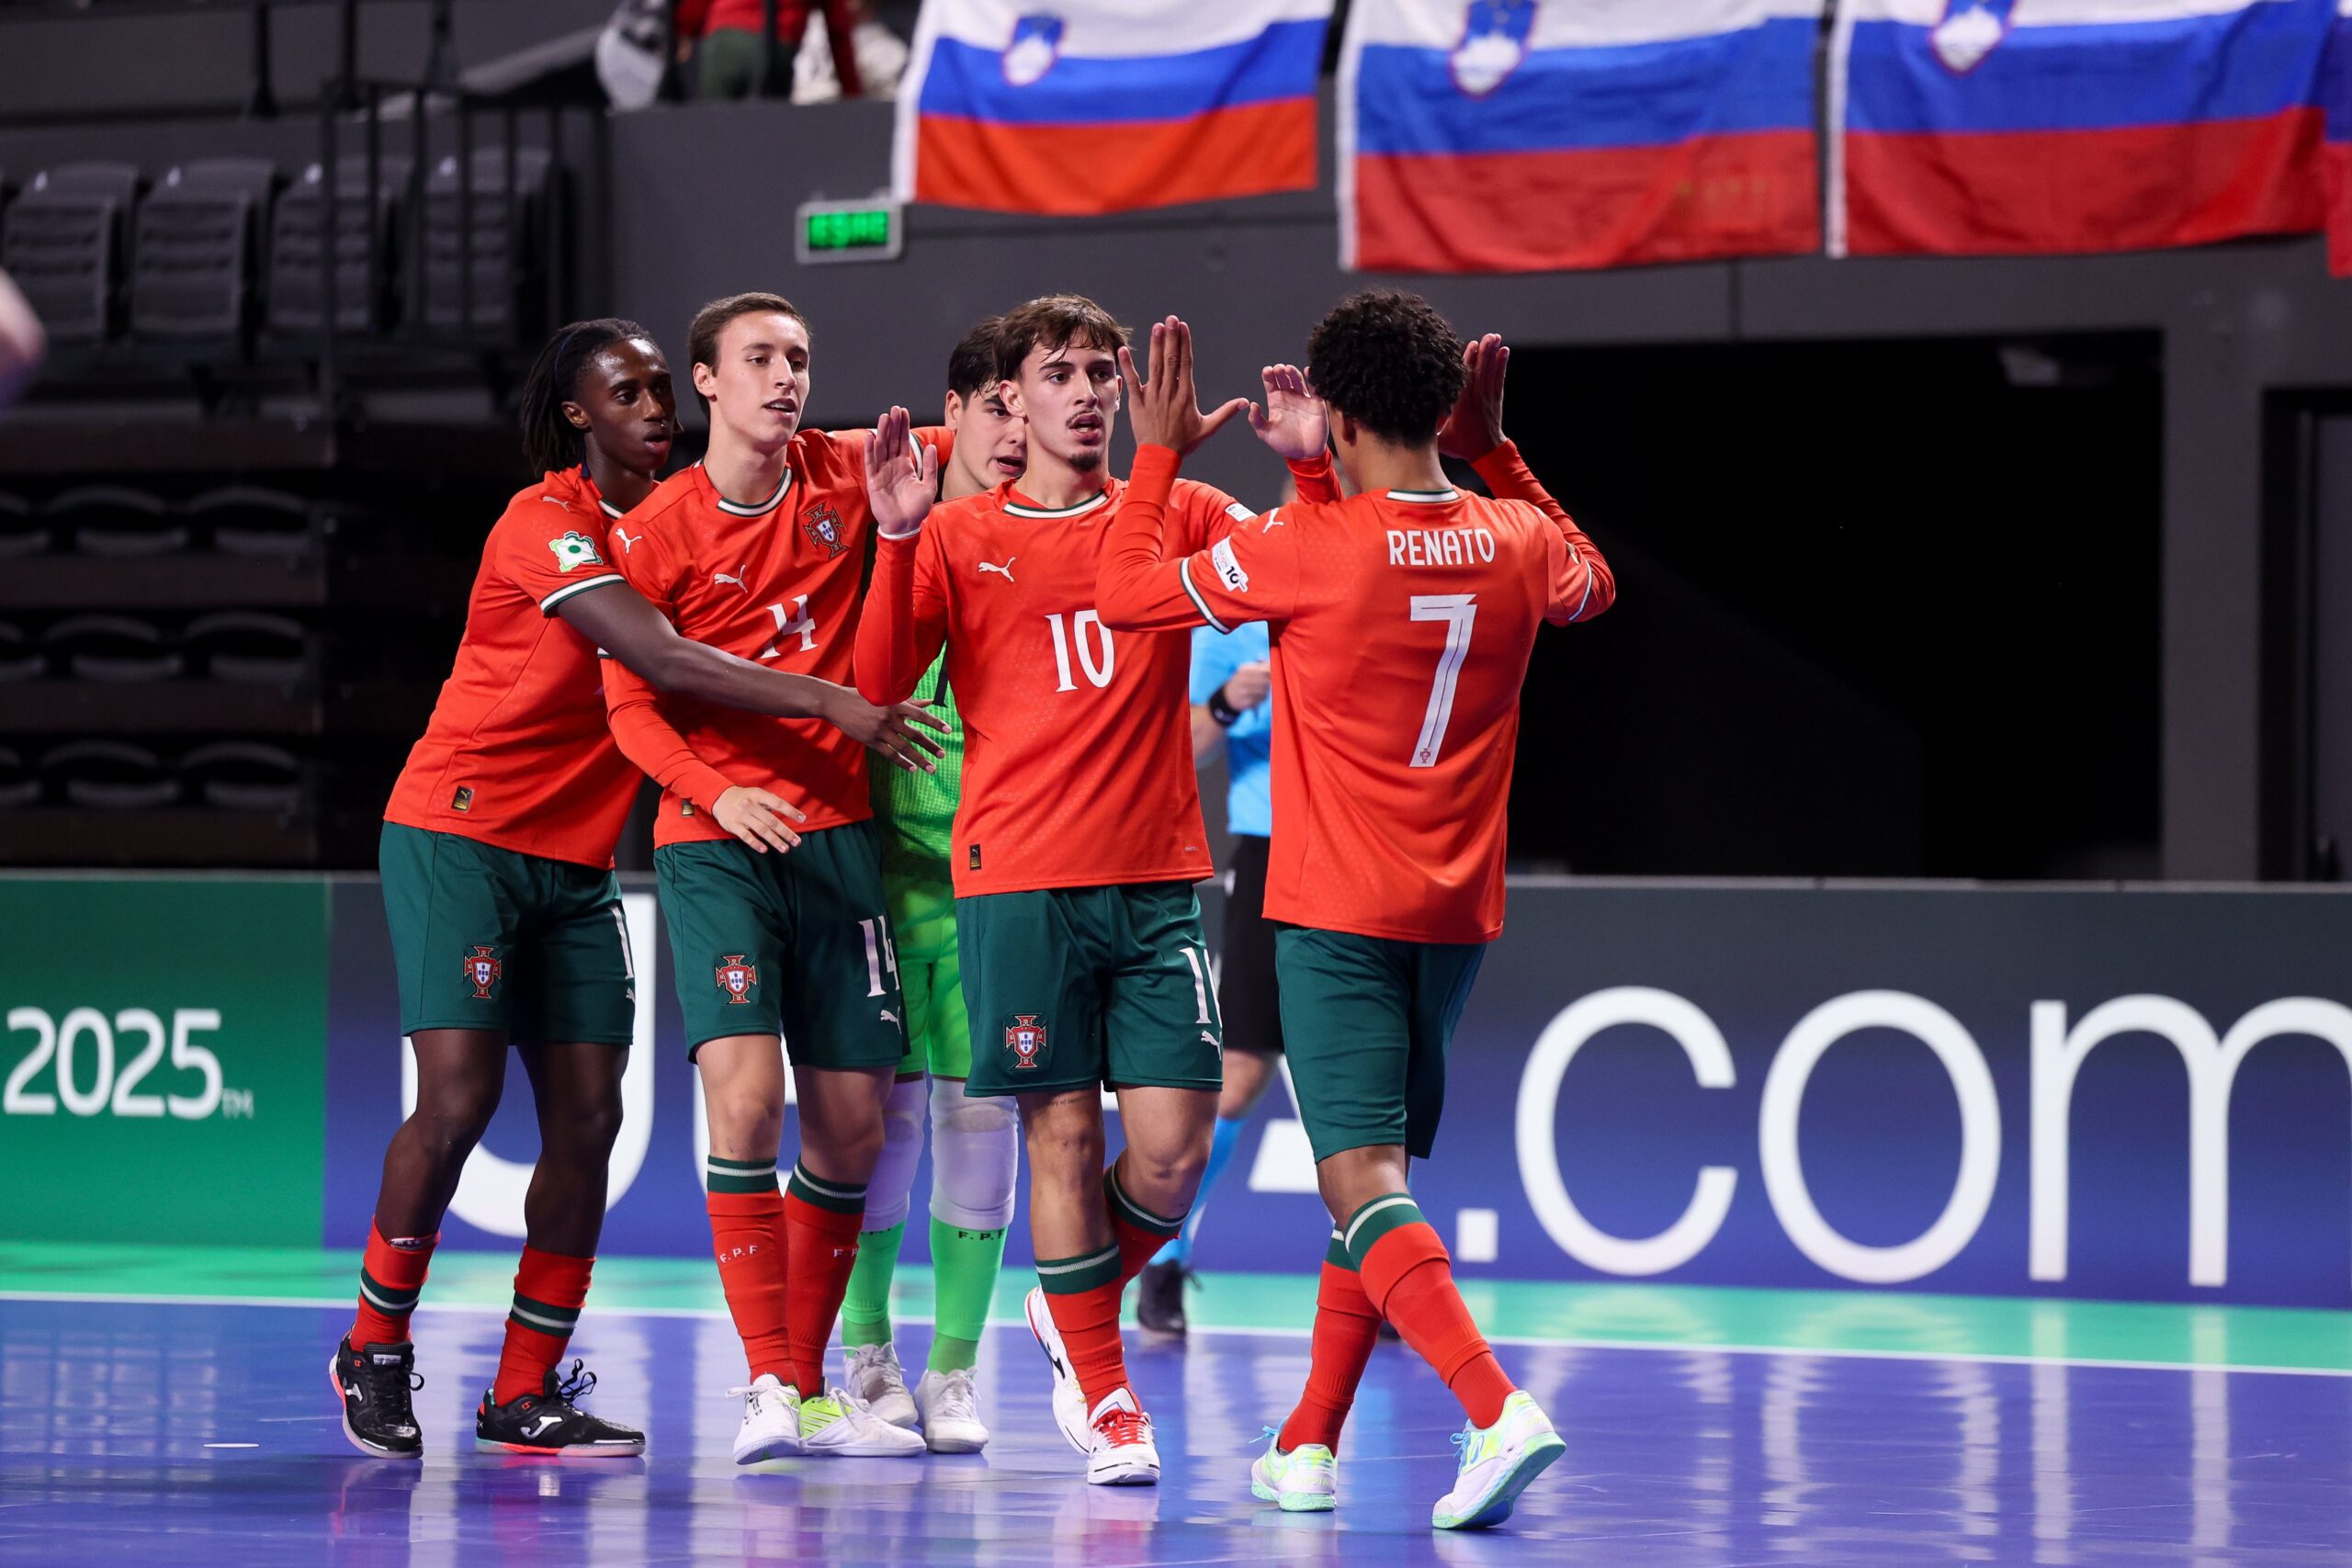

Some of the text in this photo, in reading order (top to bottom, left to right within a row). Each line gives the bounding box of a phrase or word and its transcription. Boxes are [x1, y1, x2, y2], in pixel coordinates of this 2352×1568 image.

[1387, 529, 1495, 566] RENATO
[760, 593, 819, 660] 14
[1044, 610, 1115, 693] 10
[1409, 593, 1477, 768] 7
[1179, 947, 1223, 1028] 1
